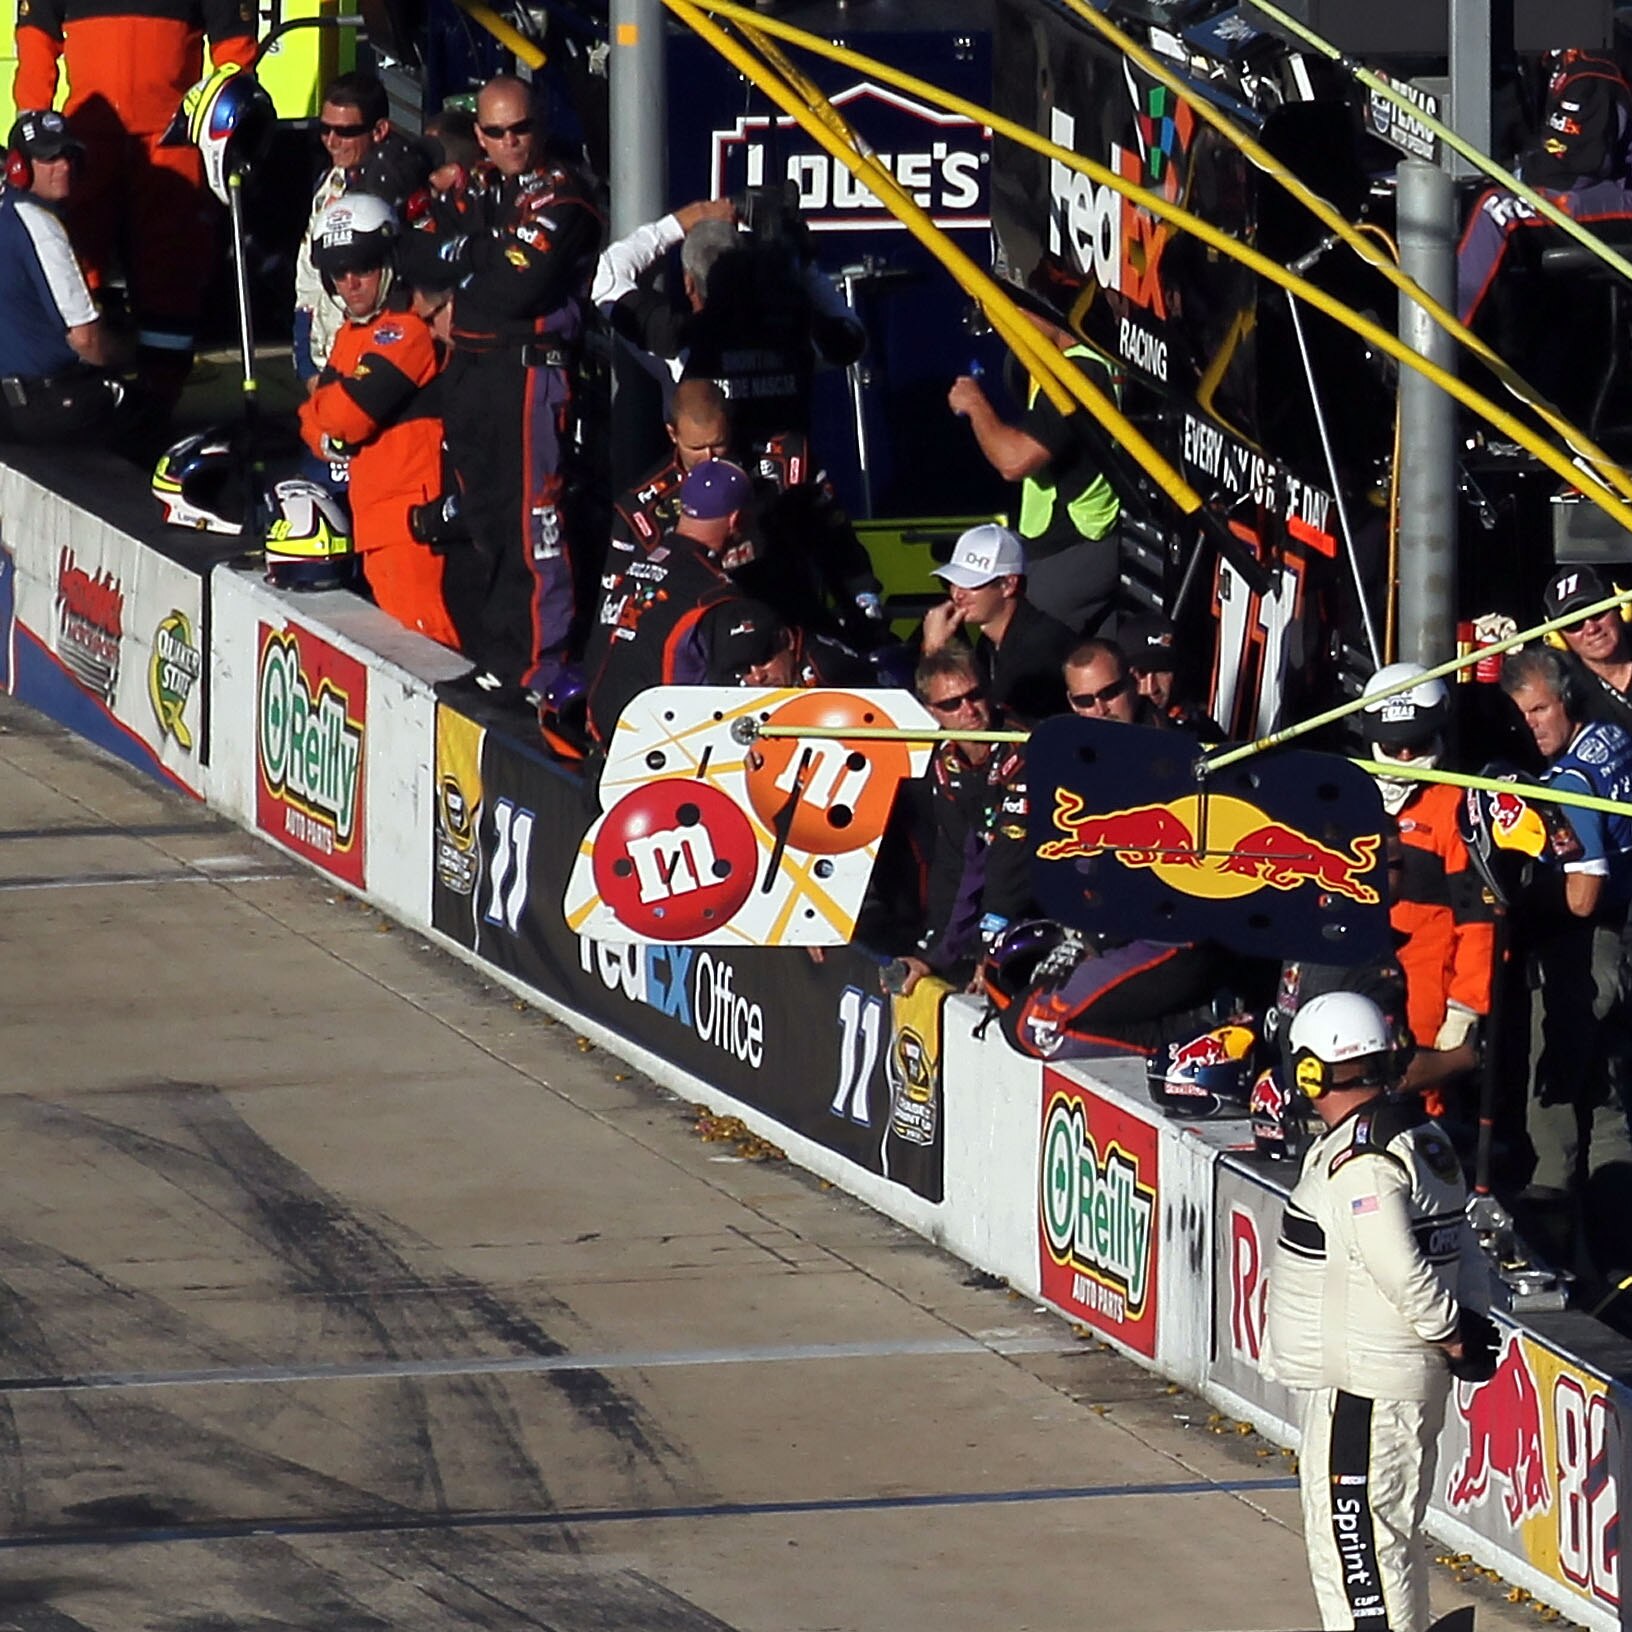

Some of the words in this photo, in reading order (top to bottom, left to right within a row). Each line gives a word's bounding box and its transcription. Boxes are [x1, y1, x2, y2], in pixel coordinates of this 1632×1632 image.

[1119, 318, 1169, 383] RACING
[1184, 413, 1224, 477] EVERY
[1556, 573, 1579, 601] 11
[157, 627, 200, 677] QUAKER
[261, 636, 362, 840] O'Reilly
[284, 808, 310, 840] AUTO
[308, 818, 334, 854] PARTS
[487, 799, 535, 936] 11
[627, 818, 724, 904] m
[694, 951, 765, 1068] Office
[836, 985, 882, 1127] 11
[1043, 1097, 1152, 1304] O'Reilly
[1072, 1274, 1100, 1309] AUTO
[1098, 1288, 1126, 1326] PARTS
[1333, 1497, 1371, 1586] Sprint
